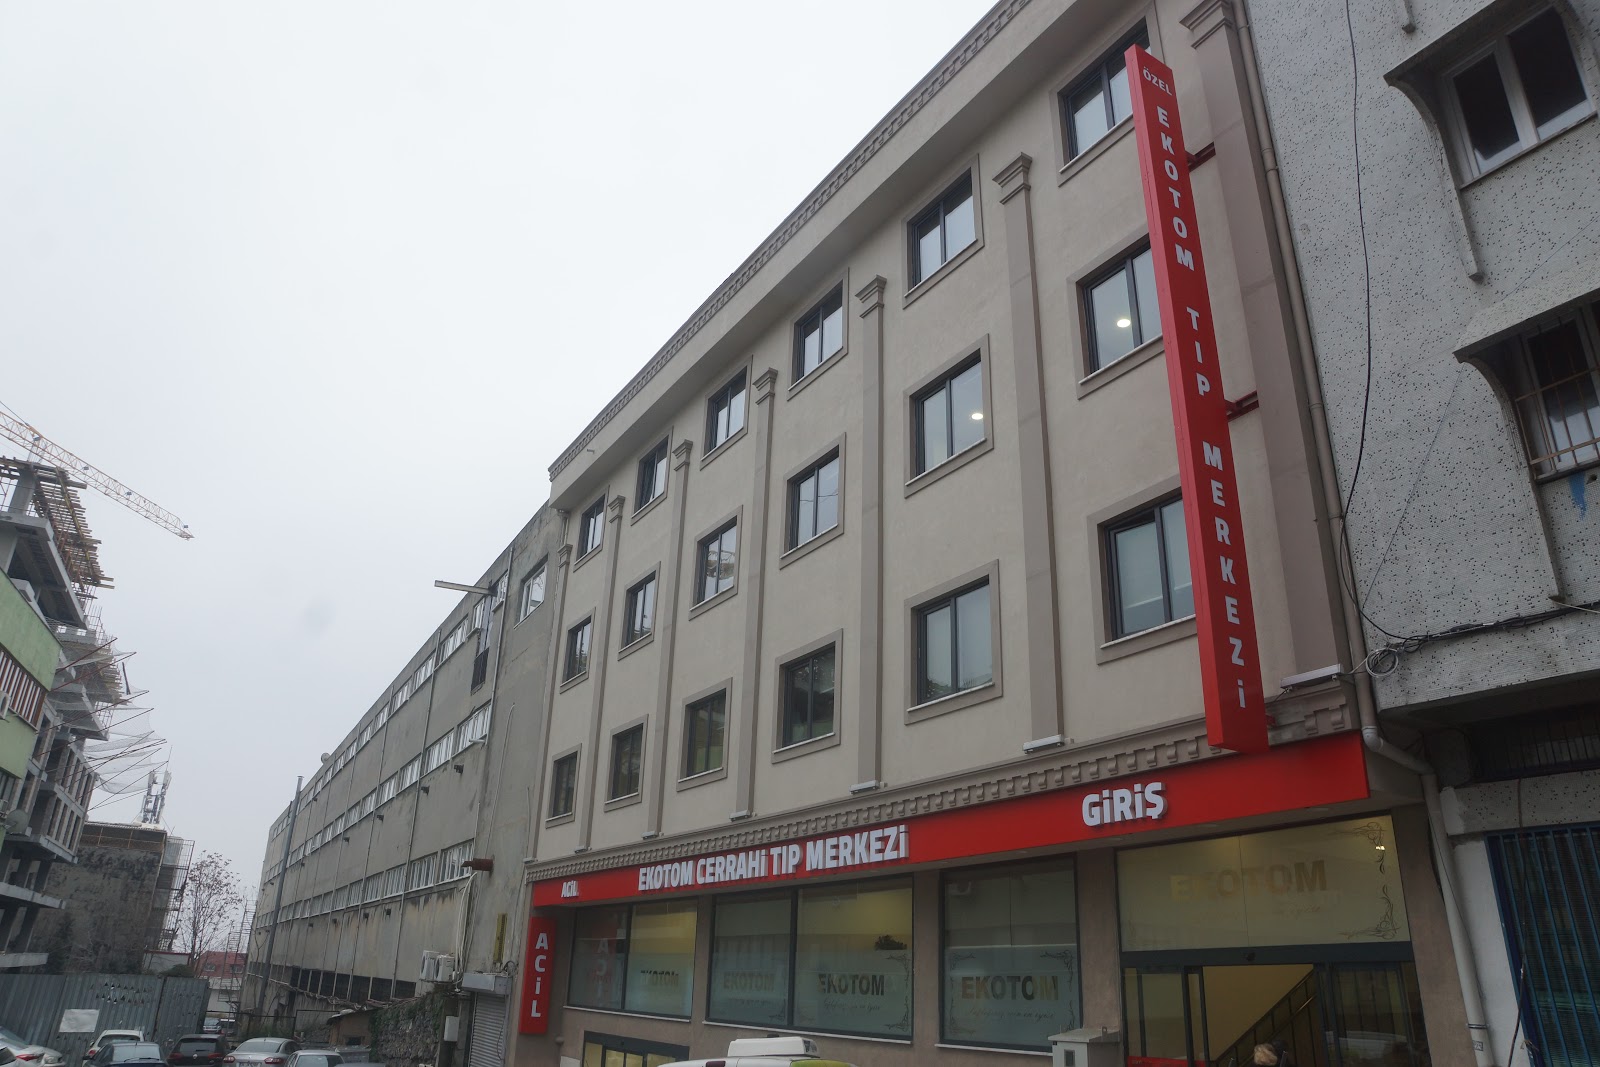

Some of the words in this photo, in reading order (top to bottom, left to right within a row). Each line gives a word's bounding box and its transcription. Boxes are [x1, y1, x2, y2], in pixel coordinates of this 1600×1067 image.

[1142, 65, 1173, 97] ÖZEL
[1156, 104, 1195, 272] EKOTOM
[1186, 306, 1211, 397] TIP
[637, 859, 694, 891] EKOTOM
[770, 843, 802, 876] TIP
[817, 973, 885, 996] EKOTOM
[961, 975, 1059, 1001] EKOTOM
